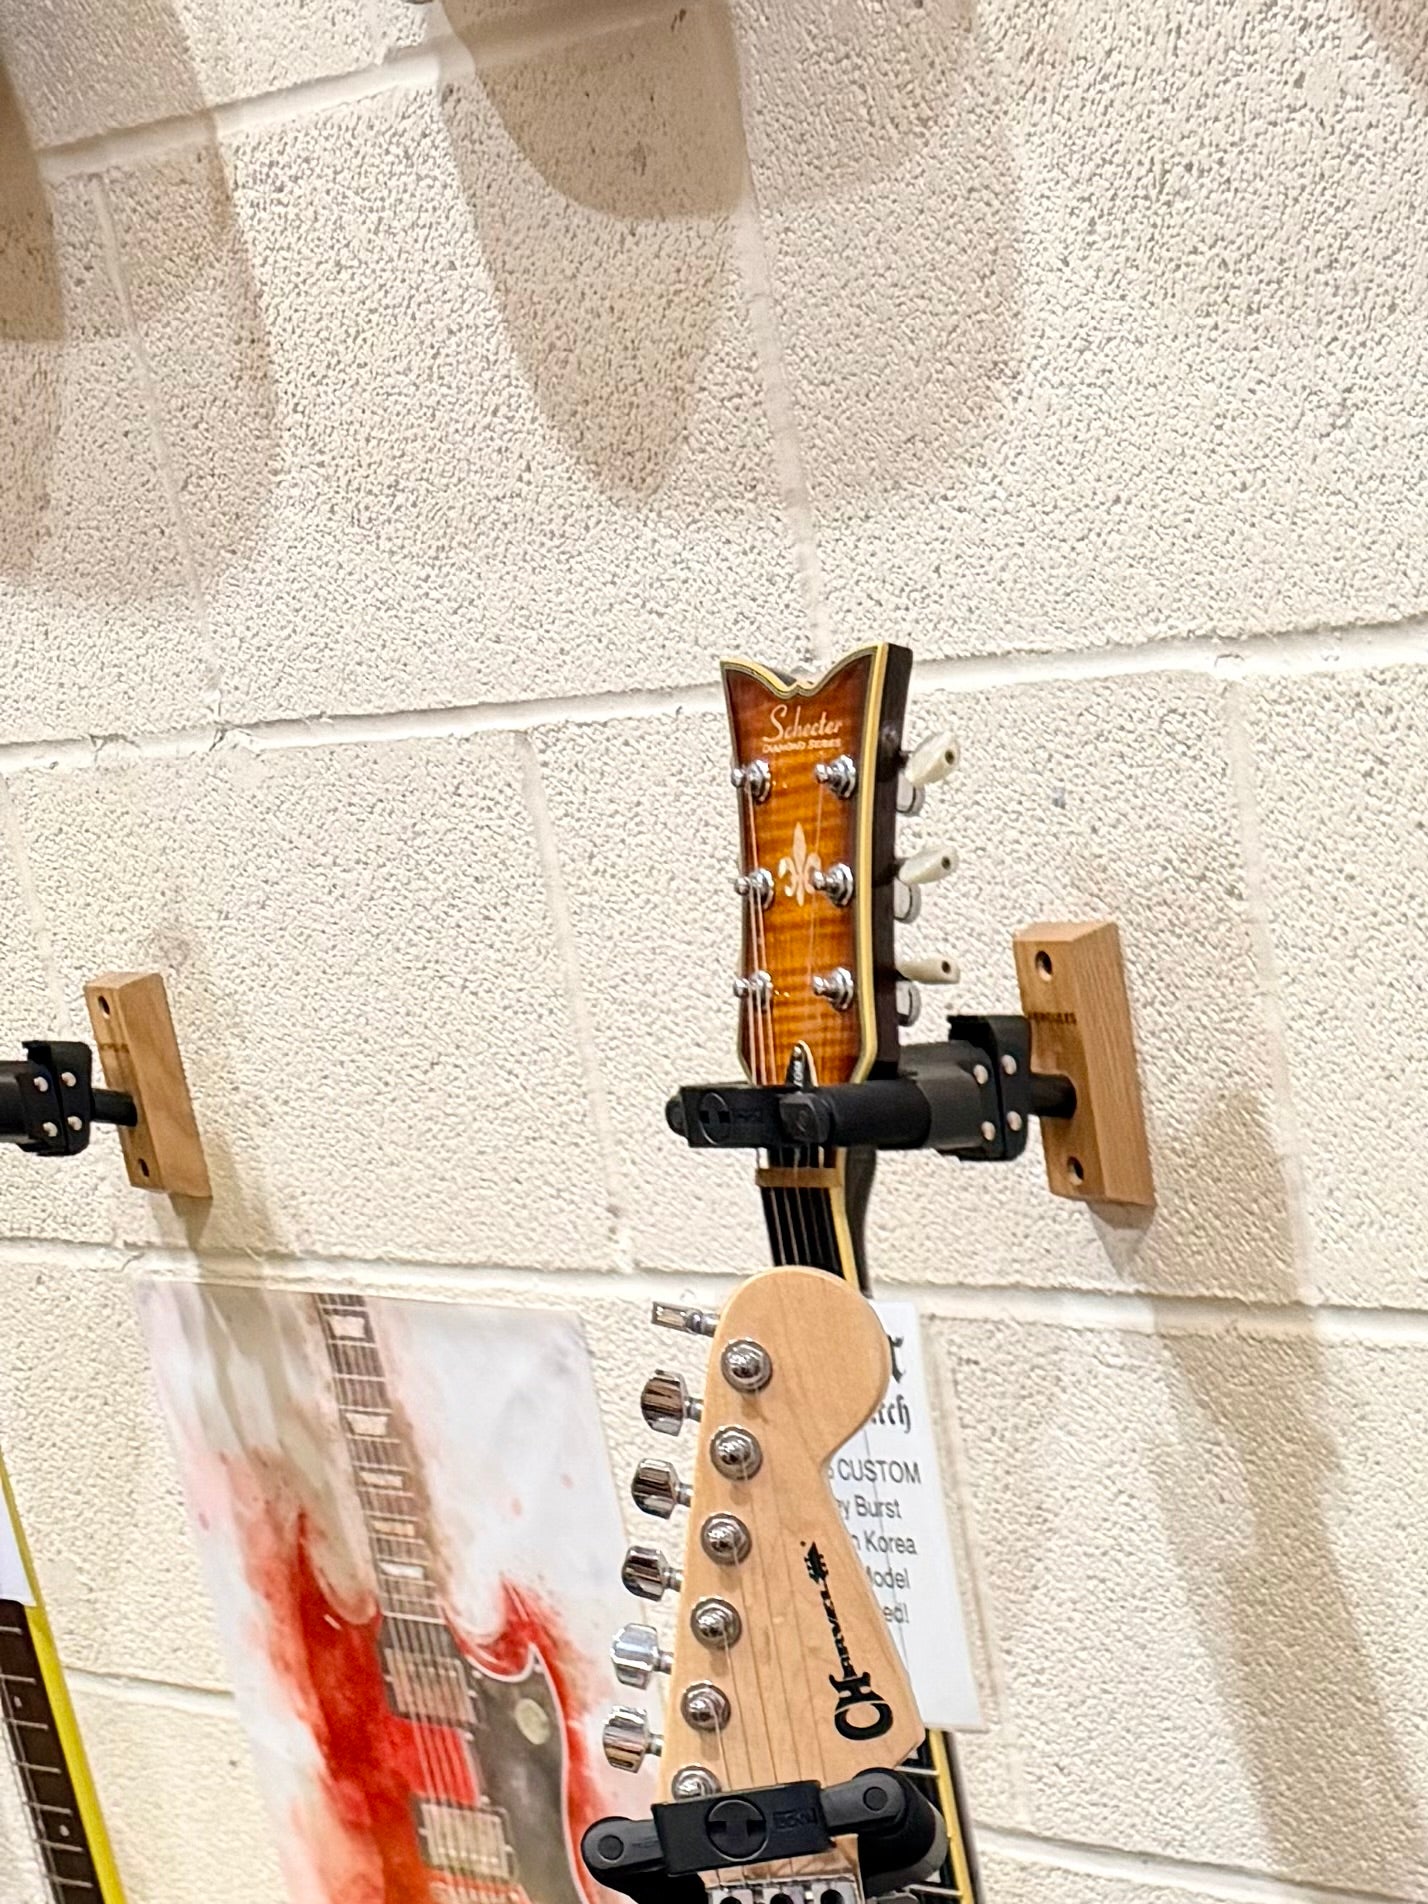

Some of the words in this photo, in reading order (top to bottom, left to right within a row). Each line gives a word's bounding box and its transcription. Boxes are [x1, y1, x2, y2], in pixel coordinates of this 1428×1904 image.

[762, 704, 843, 742] Schecter
[762, 740, 806, 753] DIAMOND
[837, 1458, 922, 1484] CUSTOM
[854, 1494, 902, 1519] Burst
[864, 1530, 918, 1556] Korea
